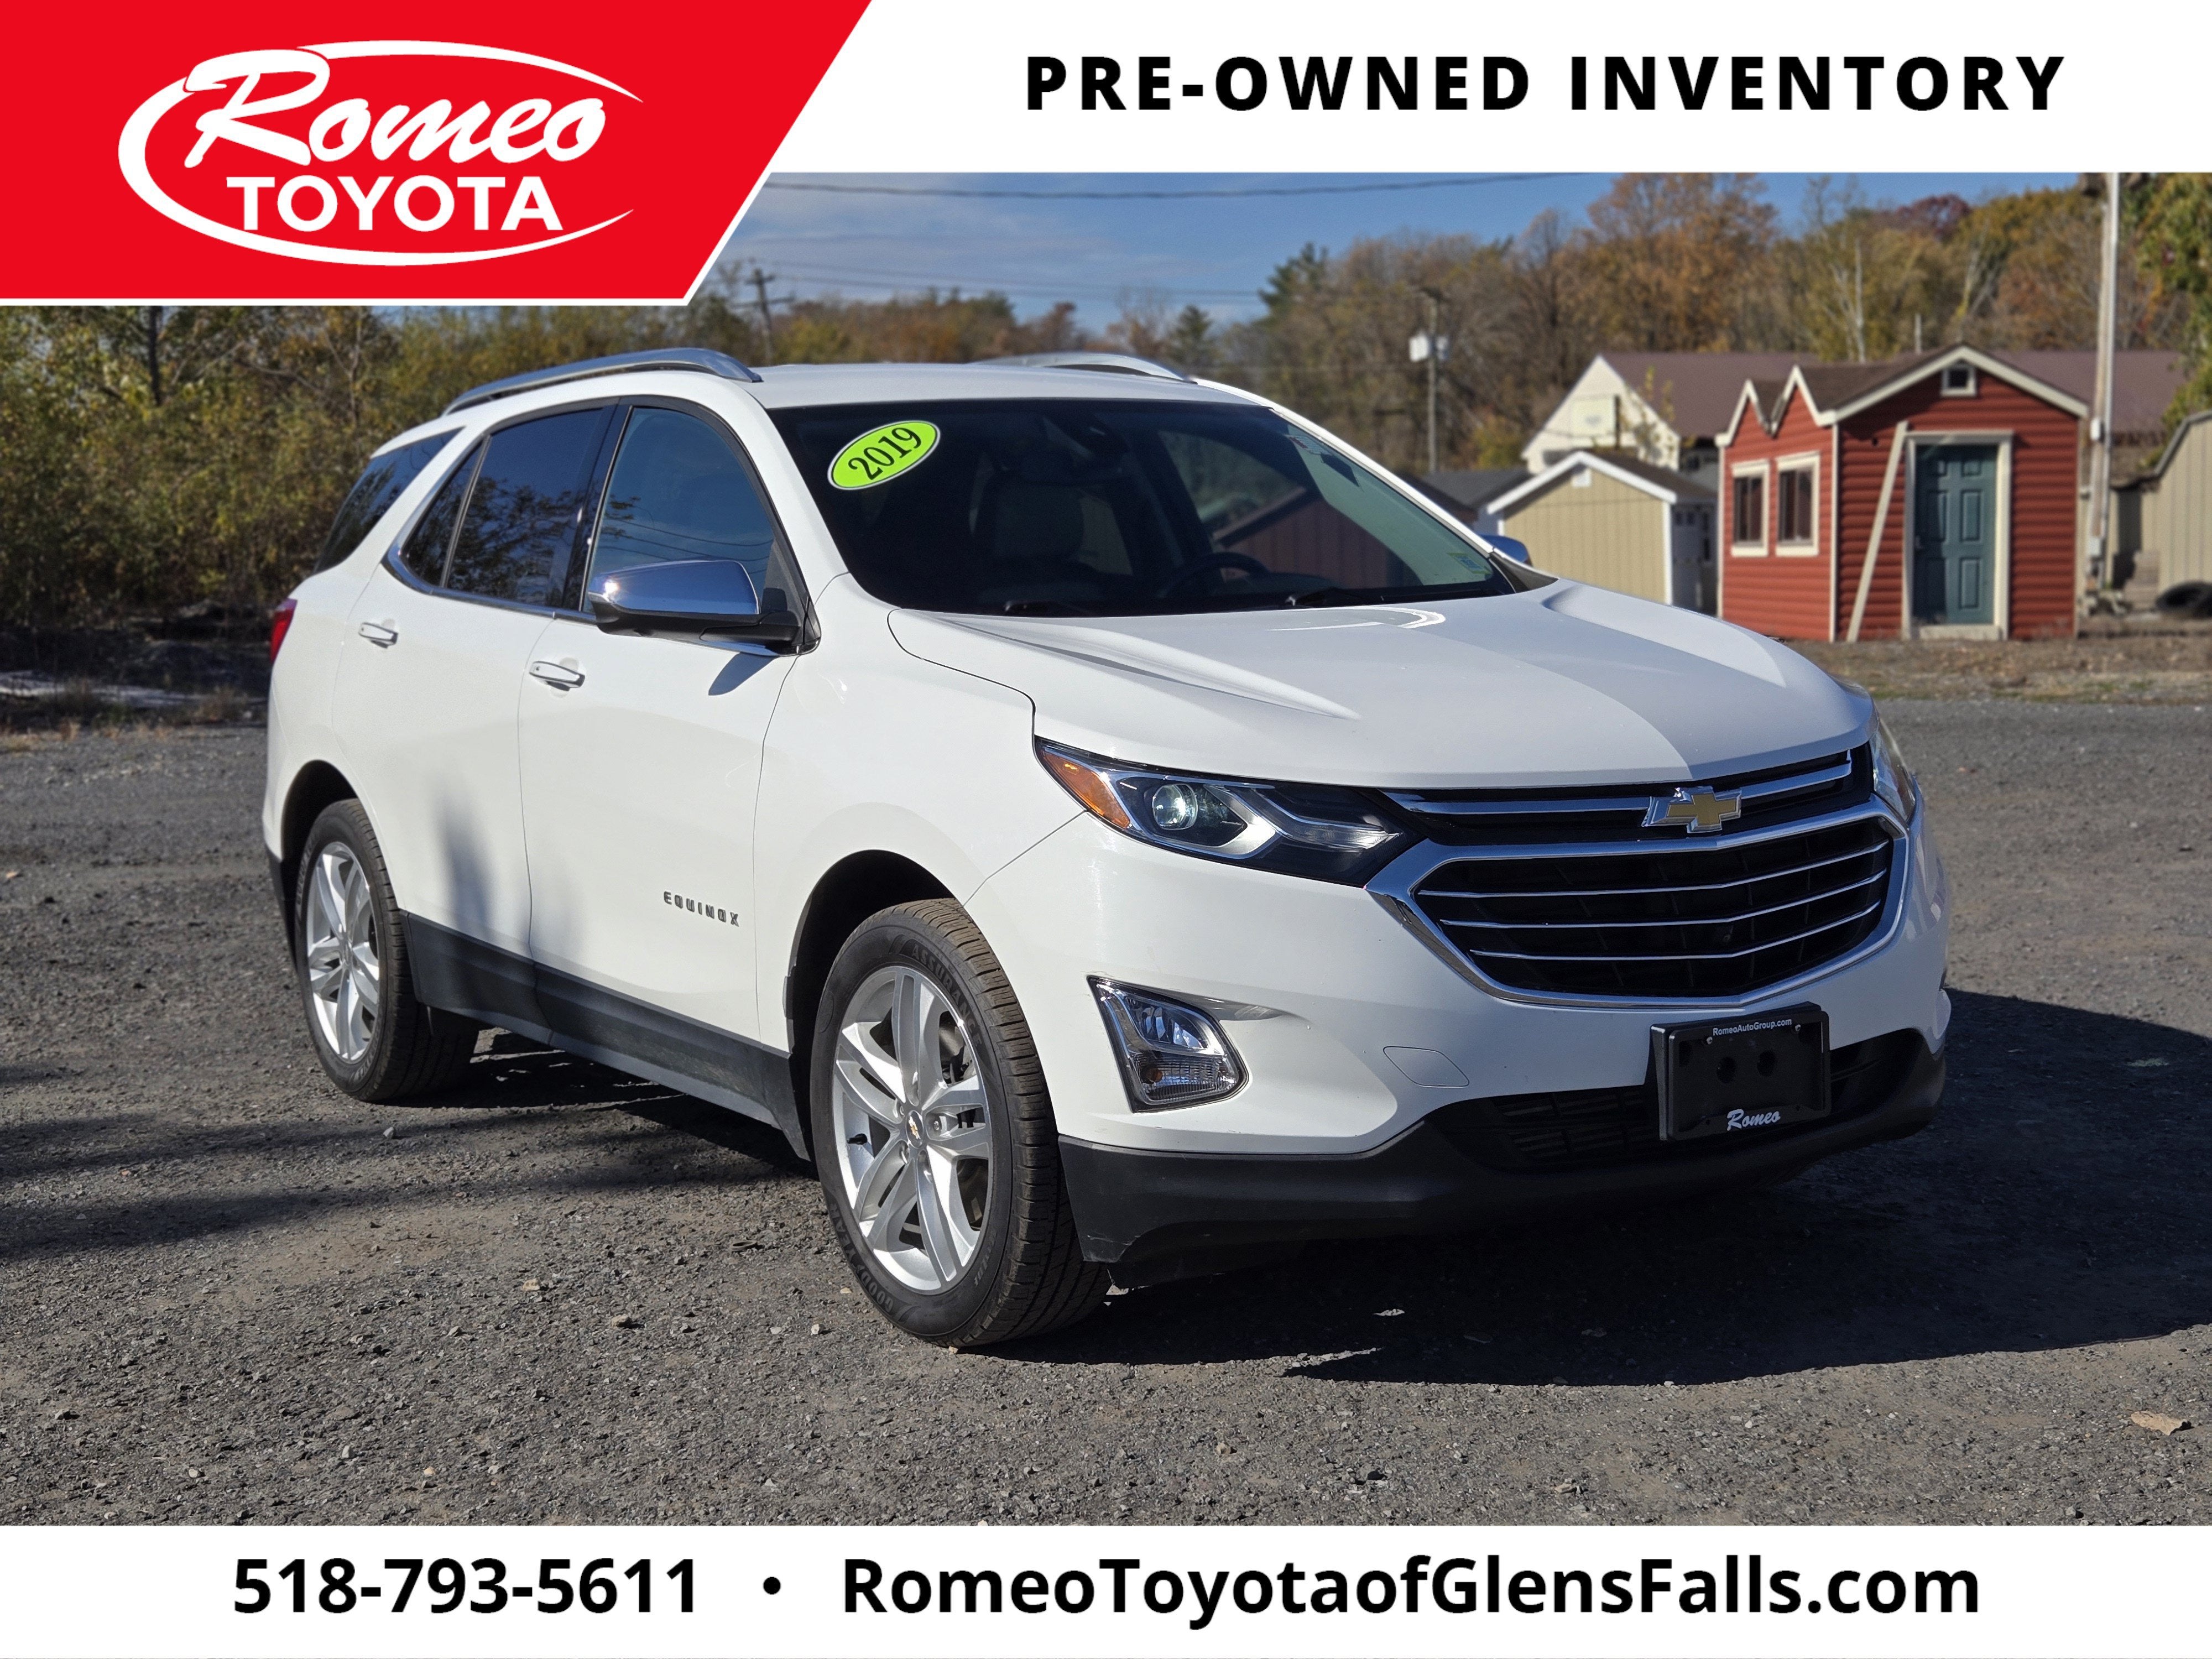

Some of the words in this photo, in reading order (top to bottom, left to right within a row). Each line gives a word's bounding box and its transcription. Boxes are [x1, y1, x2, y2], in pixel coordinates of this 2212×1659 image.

[848, 427, 922, 480] 2019
[664, 891, 739, 927] EQUINOX
[912, 943, 982, 1047] ASSURANCE
[1713, 1019, 1792, 1036] RomeoAutoGroup.com
[1726, 1109, 1781, 1131] Romeo
